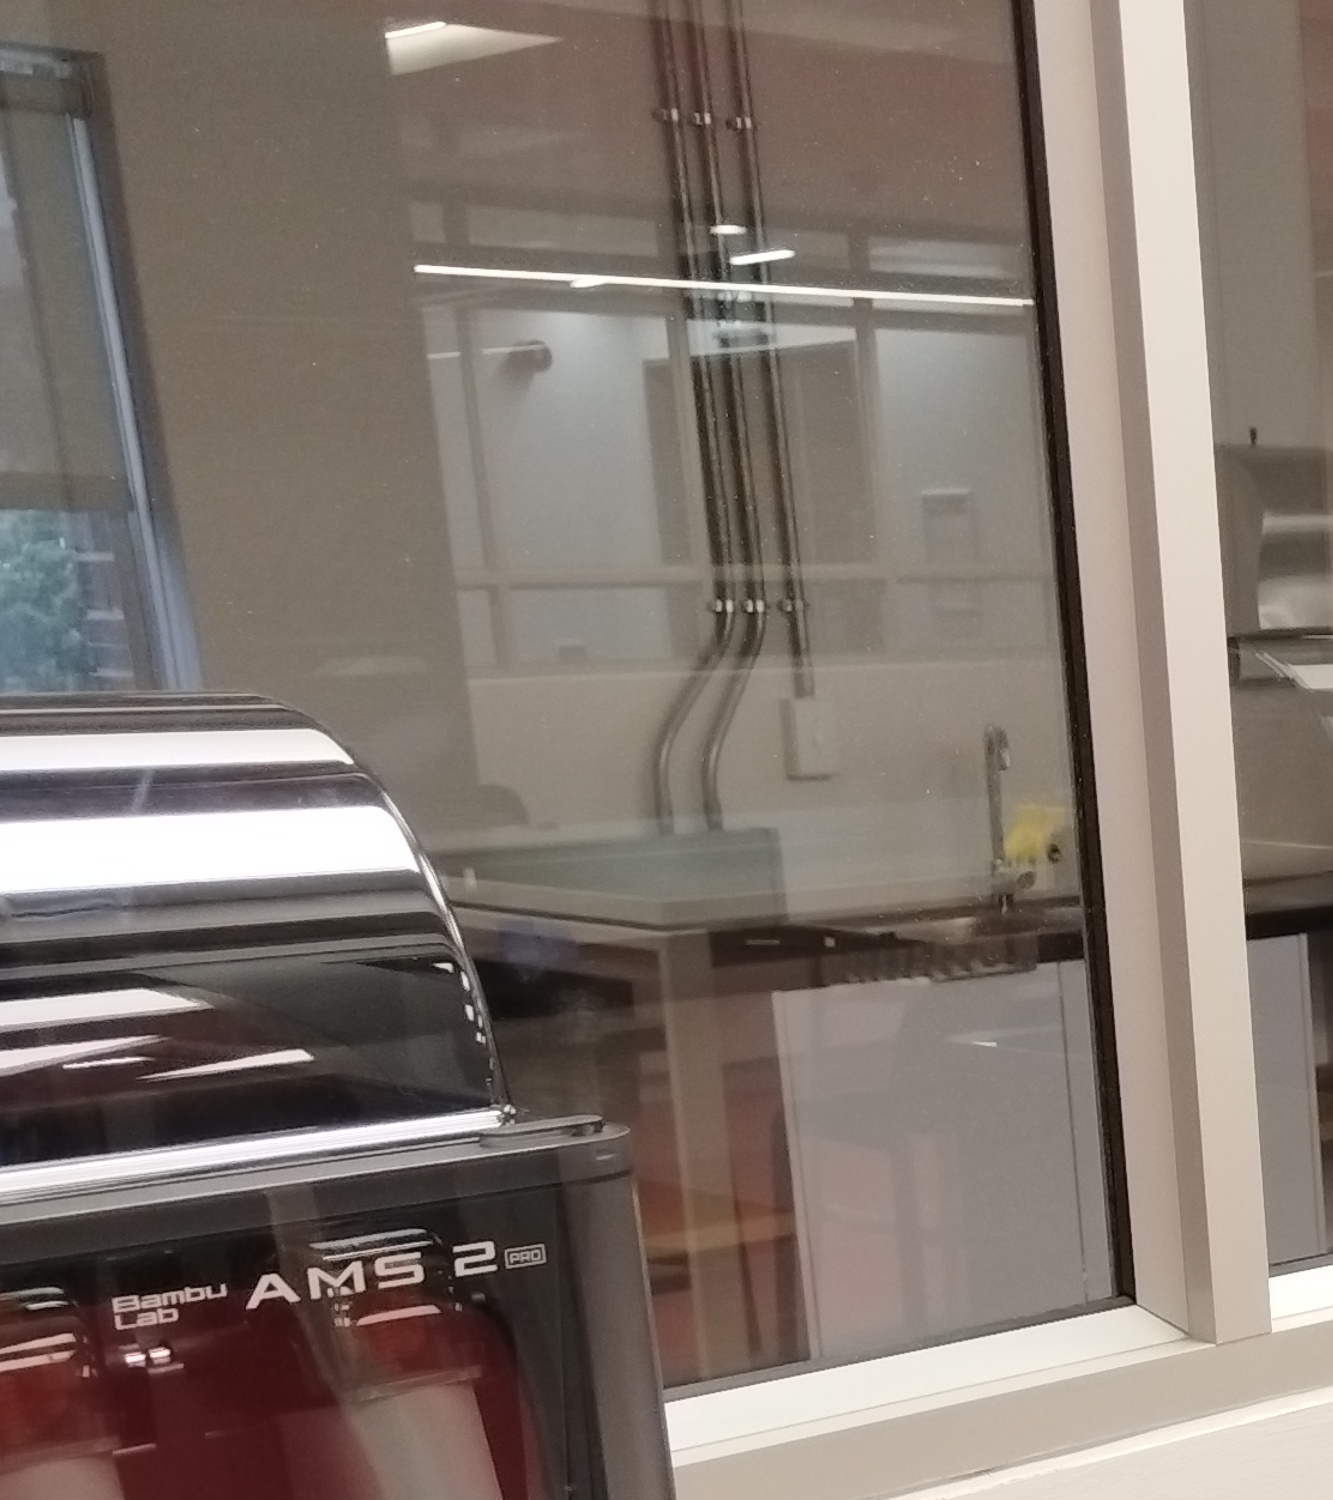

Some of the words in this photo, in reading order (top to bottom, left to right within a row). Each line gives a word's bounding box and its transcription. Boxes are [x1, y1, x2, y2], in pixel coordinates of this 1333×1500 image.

[246, 1251, 425, 1311] AMS
[453, 1240, 498, 1277] 2
[508, 1249, 542, 1265] PRO
[112, 1282, 228, 1314] Bambu
[114, 1307, 179, 1331] Lab
